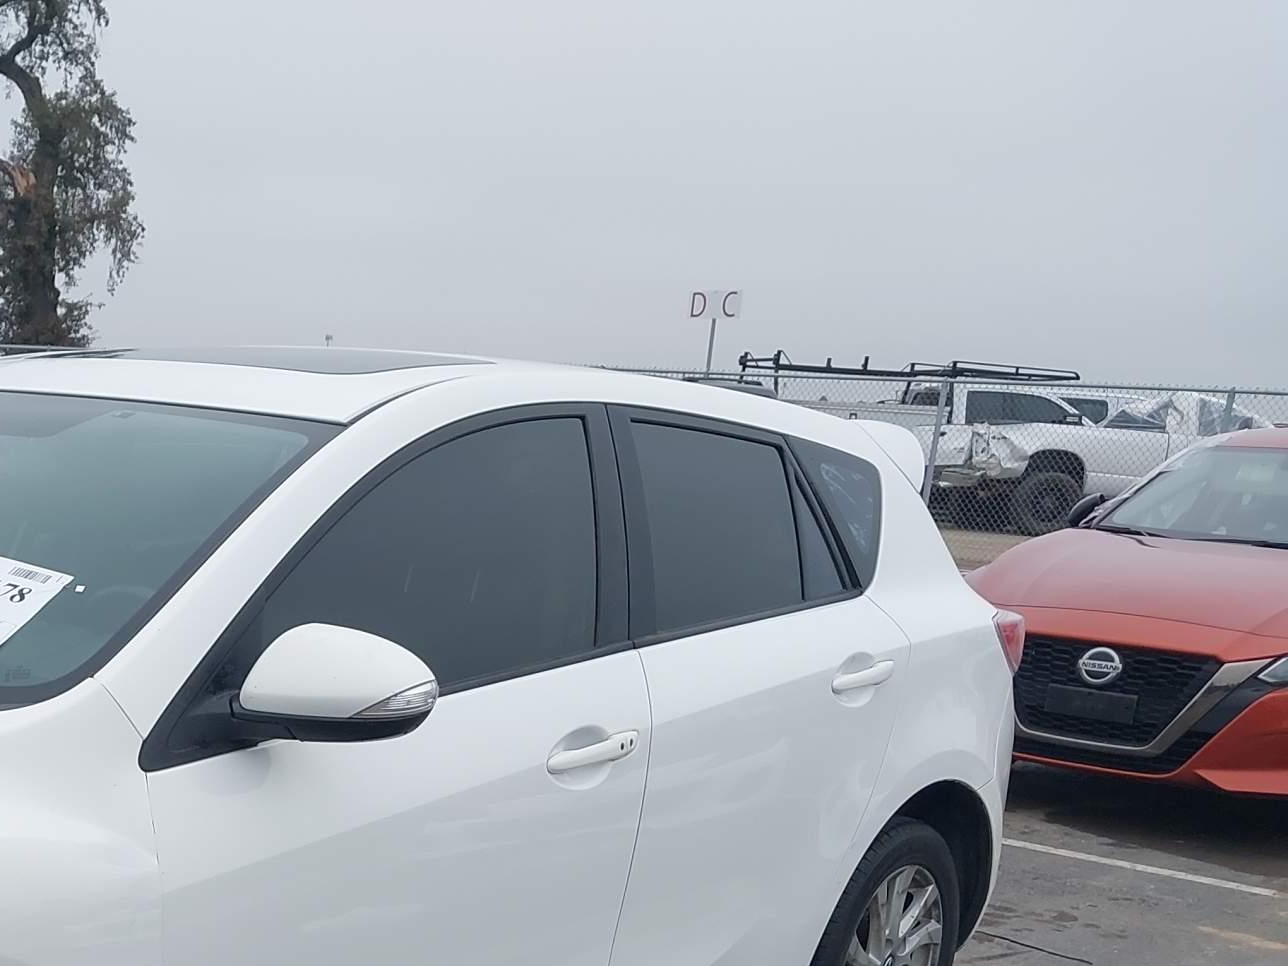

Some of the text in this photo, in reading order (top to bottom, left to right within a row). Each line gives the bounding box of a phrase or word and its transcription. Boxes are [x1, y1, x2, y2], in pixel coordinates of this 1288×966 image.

[690, 290, 738, 318] D C
[1081, 660, 1121, 671] NISSAN
